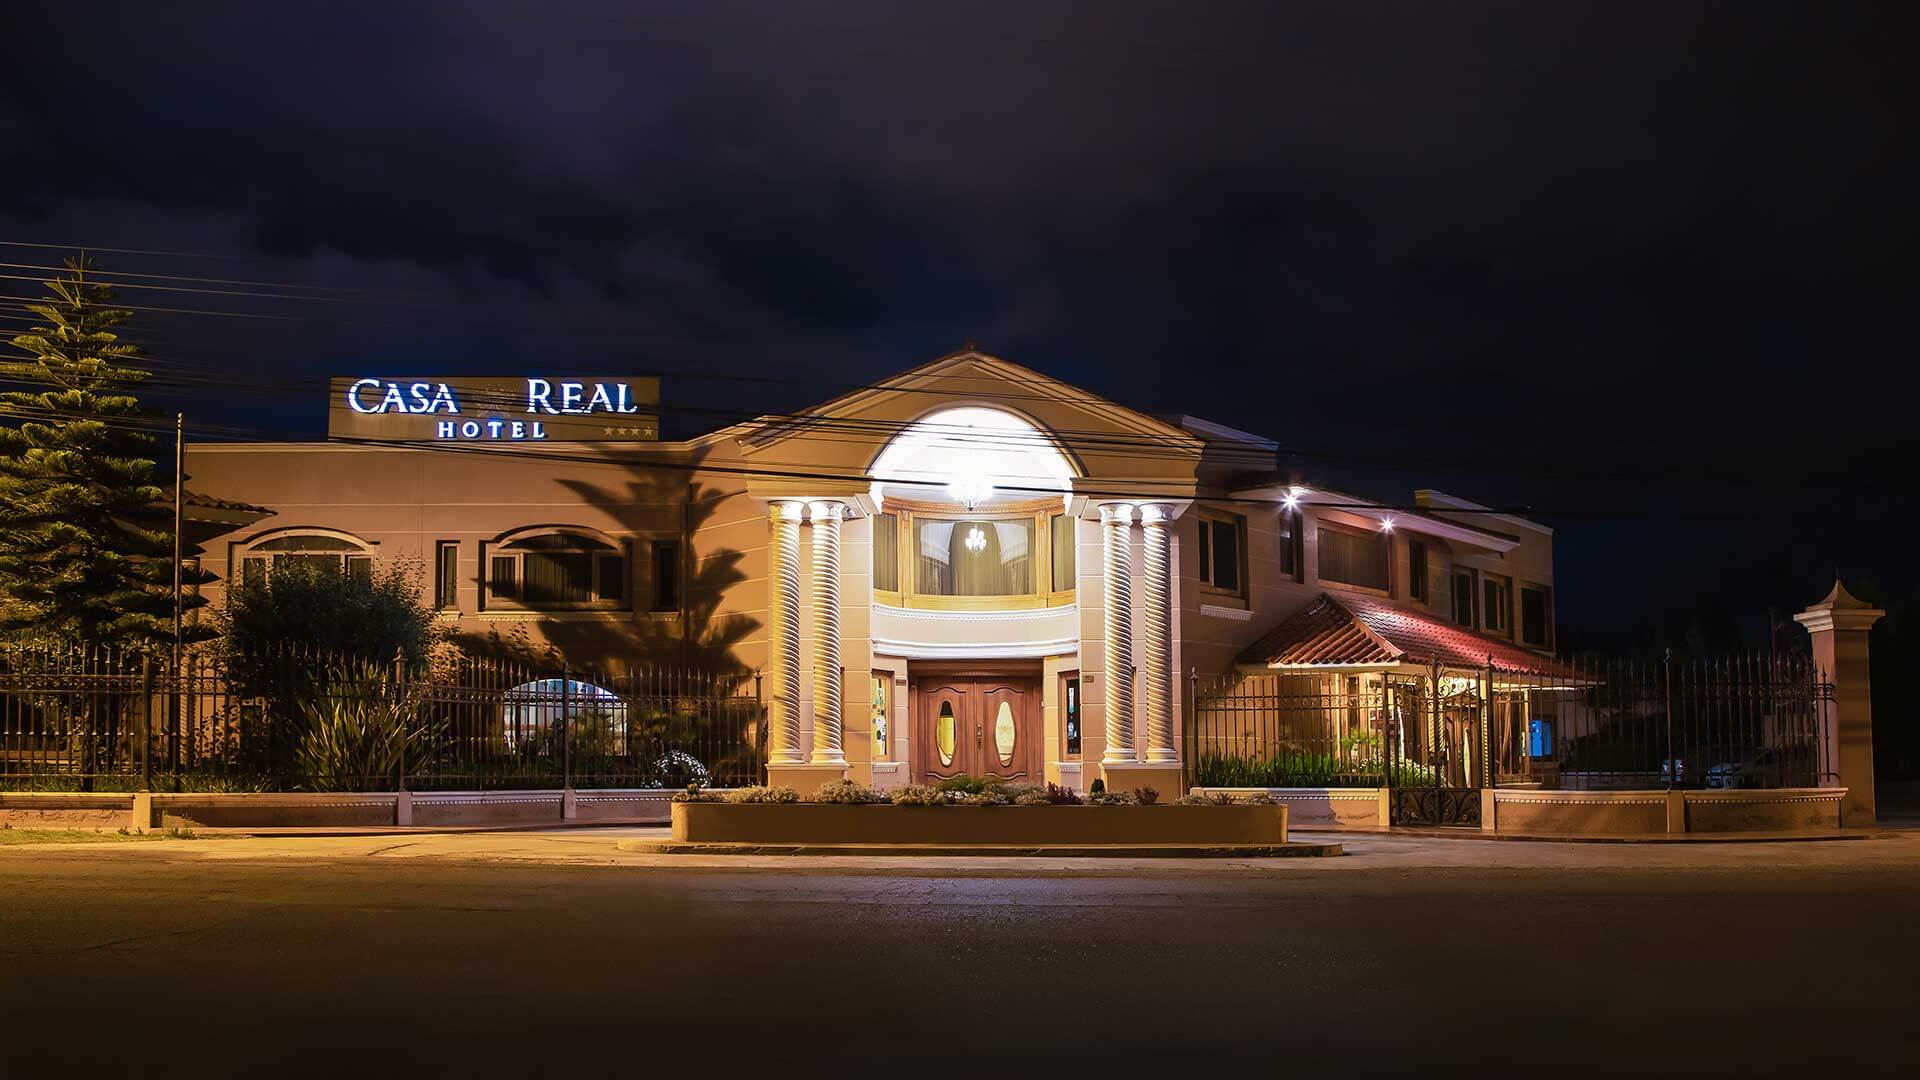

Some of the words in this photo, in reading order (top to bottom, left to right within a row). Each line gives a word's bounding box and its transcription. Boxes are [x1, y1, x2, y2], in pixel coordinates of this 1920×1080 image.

[348, 378, 458, 414] CASA
[526, 378, 638, 415] REAL
[438, 421, 545, 438] HOTEL
